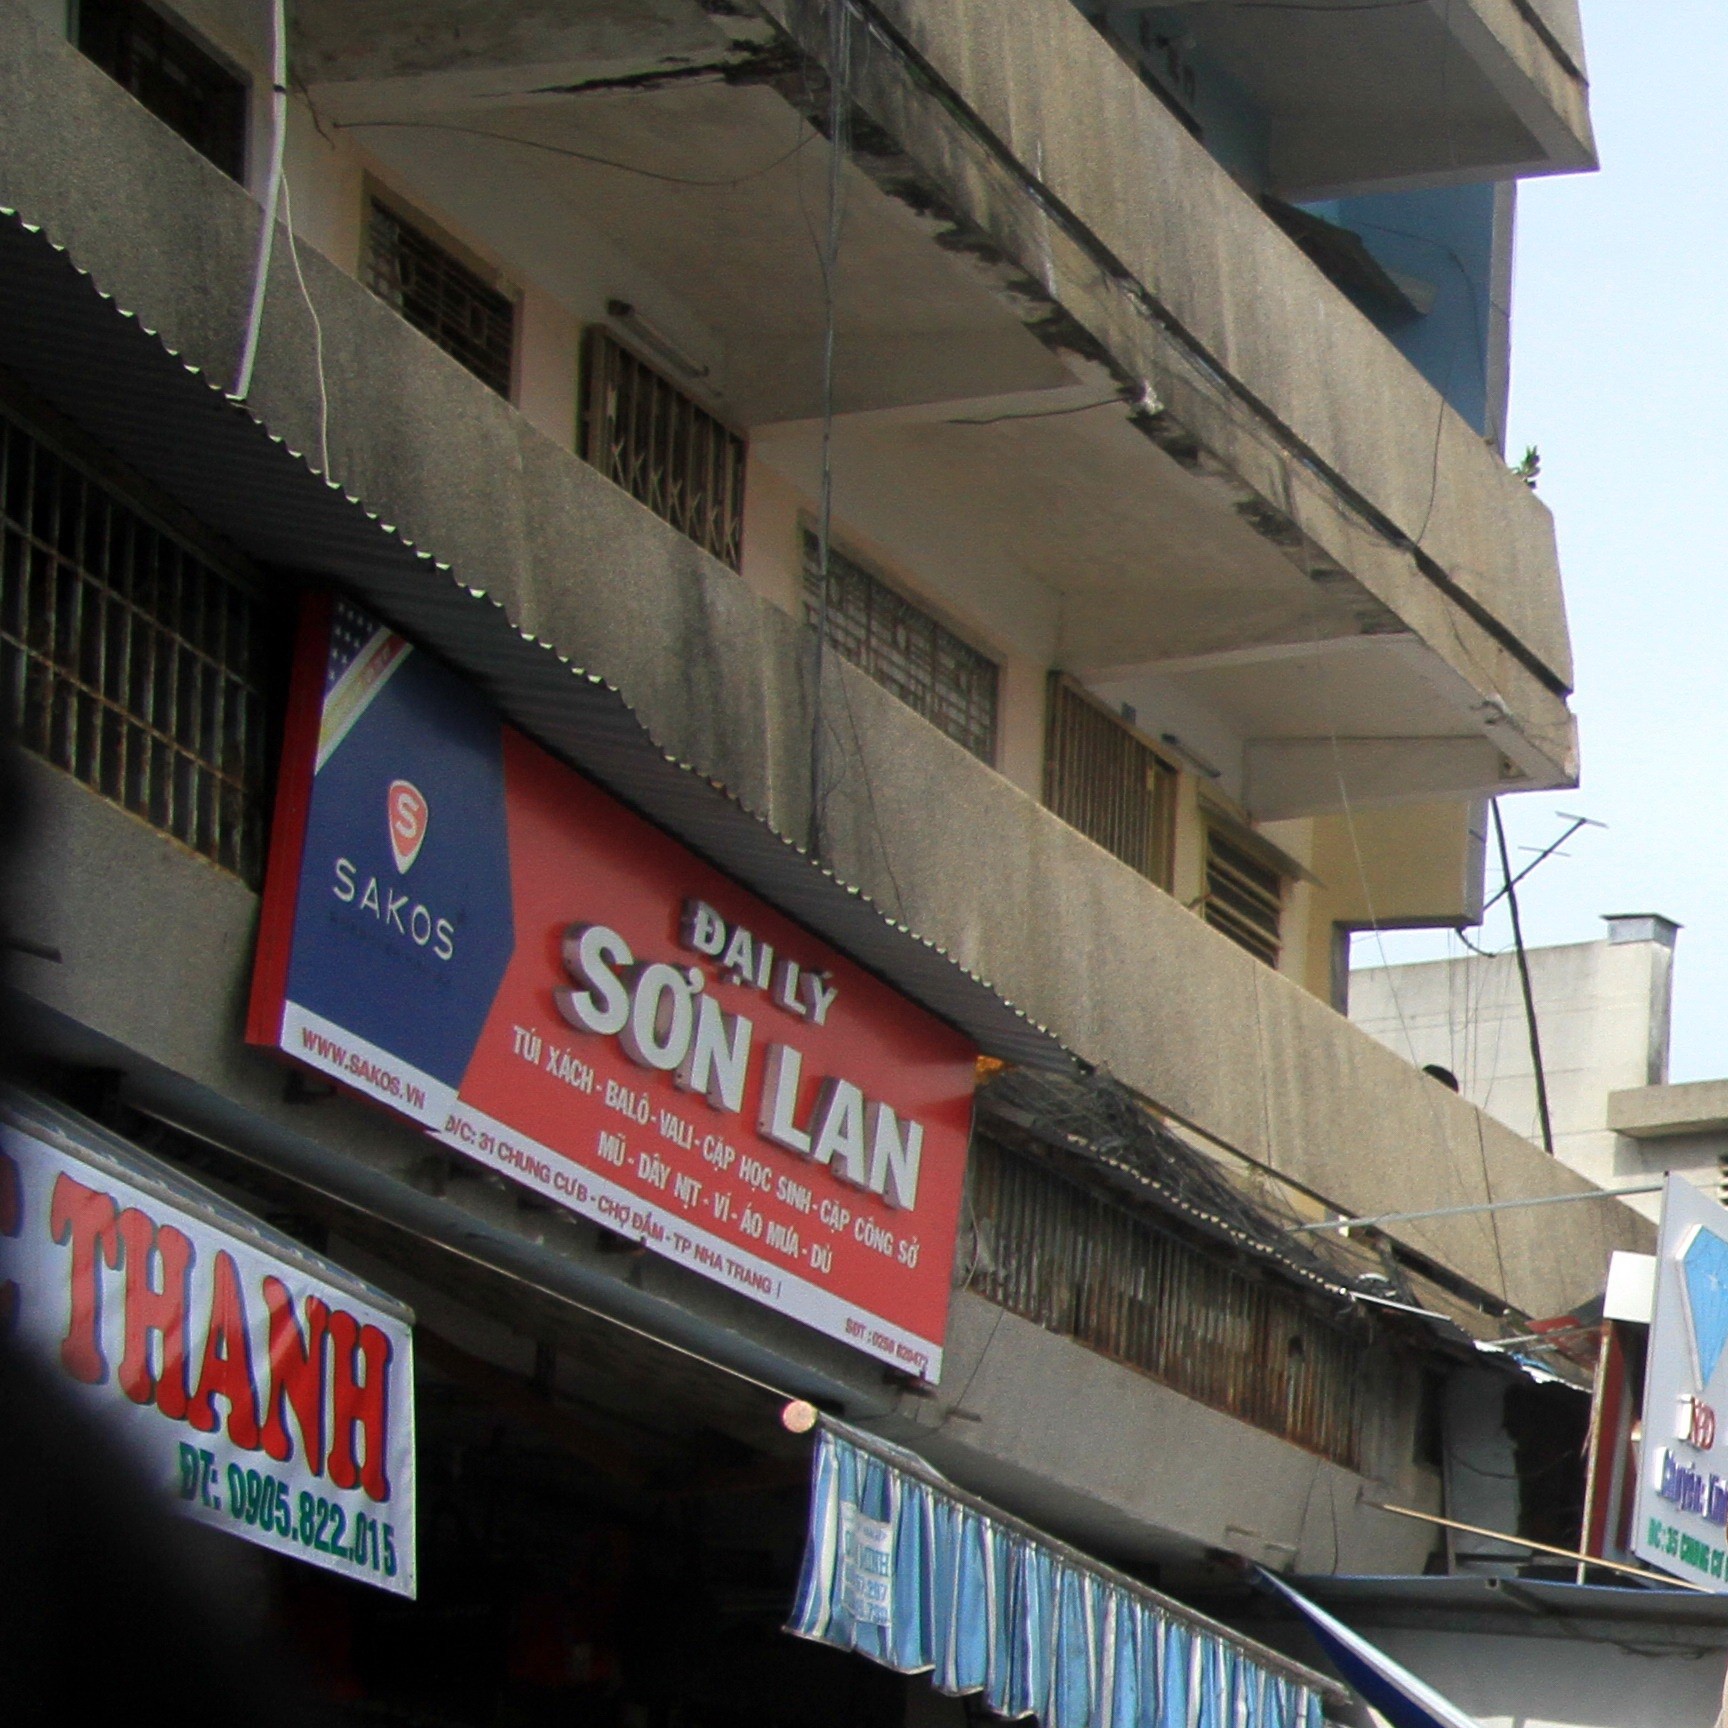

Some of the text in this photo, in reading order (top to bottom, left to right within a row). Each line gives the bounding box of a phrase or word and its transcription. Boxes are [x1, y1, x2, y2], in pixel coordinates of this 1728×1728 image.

[331, 856, 455, 961] SAKOS
[692, 900, 838, 1025] ĐẠI LÝ
[568, 925, 753, 1113] SƠN
[768, 1044, 924, 1211] LAN
[512, 1023, 541, 1062] TÚI
[546, 1046, 594, 1095] XÁCH
[604, 1081, 650, 1126] BALÔ
[660, 1109, 694, 1150] VALI
[738, 1155, 773, 1193] HỌC
[776, 1176, 812, 1214] SINH
[854, 1217, 894, 1257] CÔNG
[897, 1235, 920, 1269] SỞ
[637, 1152, 671, 1190] DÂY
[673, 1172, 702, 1209] NỊT
[740, 1202, 763, 1239] ÁO
[498, 1142, 551, 1185] CHUNG
[673, 1231, 692, 1254] TP
[693, 1243, 723, 1271] NHA
[726, 1258, 772, 1295] TRANG
[50, 1171, 394, 1503] THANH
[227, 1462, 398, 1578] 0905.822.015
